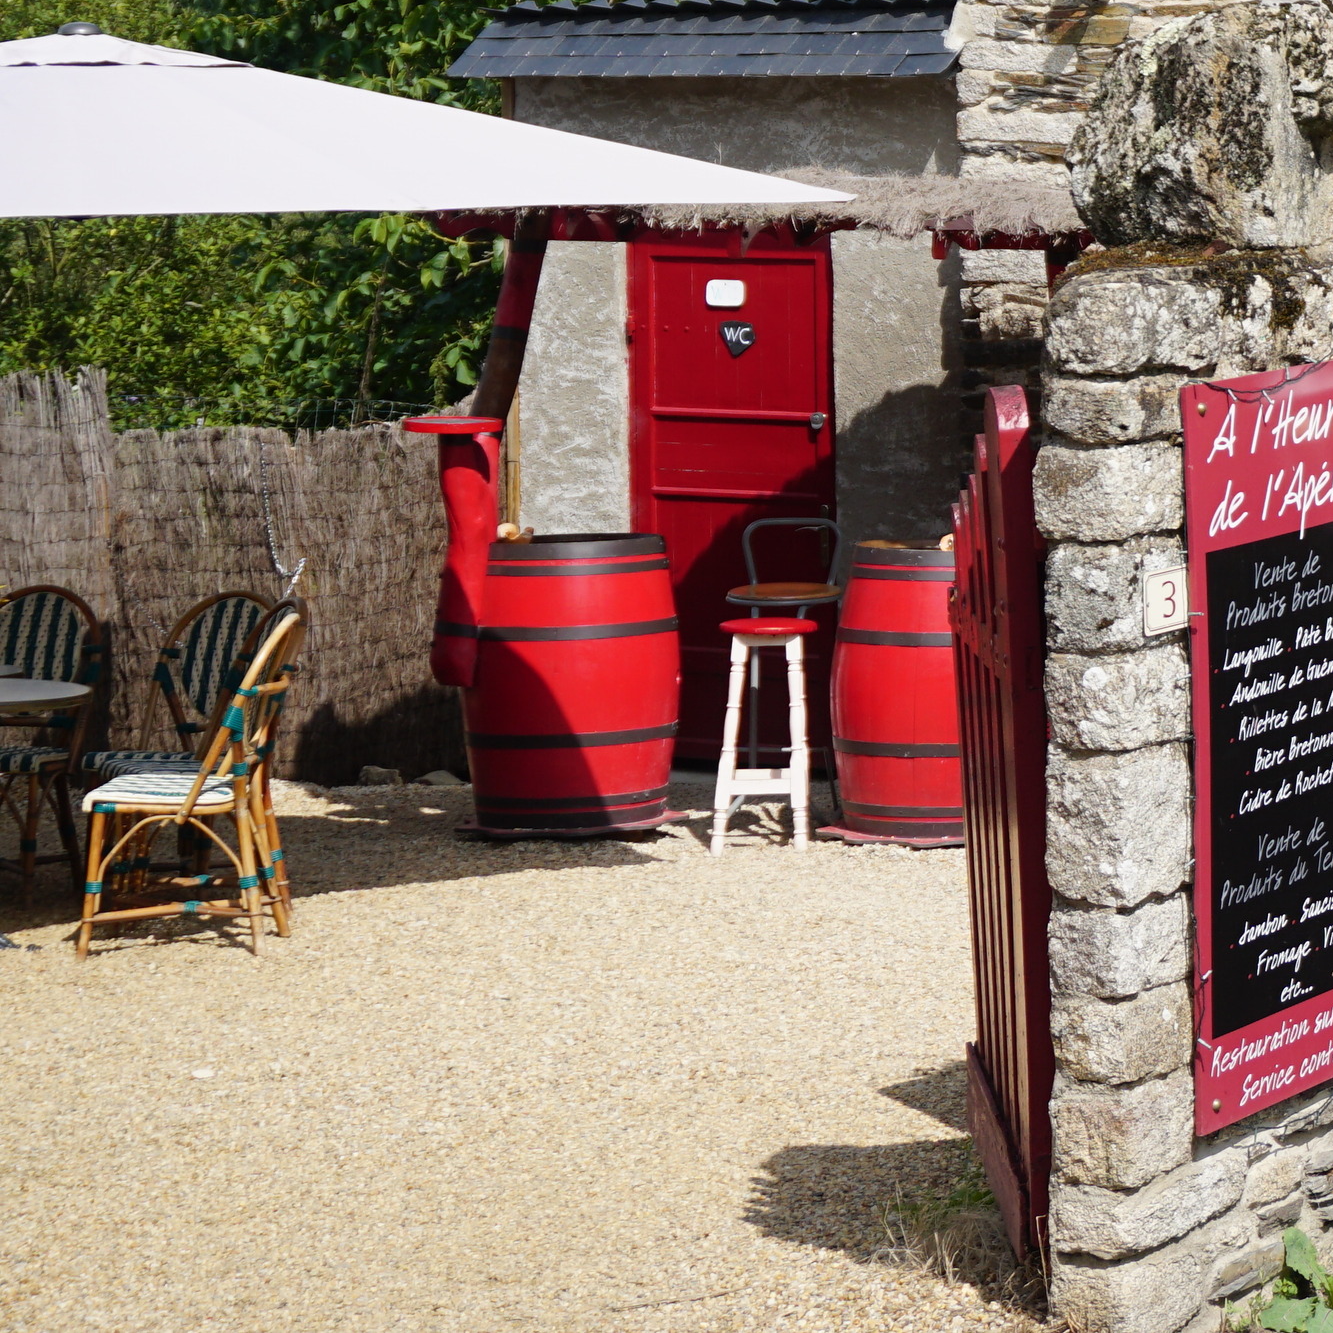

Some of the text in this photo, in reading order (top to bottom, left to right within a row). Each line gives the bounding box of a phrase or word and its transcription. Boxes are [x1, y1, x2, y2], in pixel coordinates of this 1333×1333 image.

[724, 326, 750, 345] WC
[1209, 479, 1248, 537] de
[1254, 549, 1321, 589] Vente de
[1162, 580, 1176, 618] 3
[1226, 591, 1286, 630] Produits
[1223, 638, 1284, 678] Langouille
[1295, 625, 1322, 650] Pâté
[1229, 672, 1286, 707] Andouille
[1288, 666, 1305, 689] de
[1238, 709, 1289, 741] Rillettes
[1291, 701, 1308, 724] de
[1310, 698, 1323, 717] la
[1254, 747, 1286, 772] Bière
[1239, 787, 1272, 815] Cidre
[1275, 778, 1292, 803] de
[1258, 816, 1326, 861] Vente de
[1220, 864, 1283, 910] Produits
[1288, 856, 1308, 885] du
[1238, 912, 1289, 945] Jambon
[1256, 940, 1312, 976] Fromage
[1280, 978, 1314, 1003] etc...
[1211, 1019, 1311, 1078] Restauration
[1239, 1064, 1296, 1107] Service
